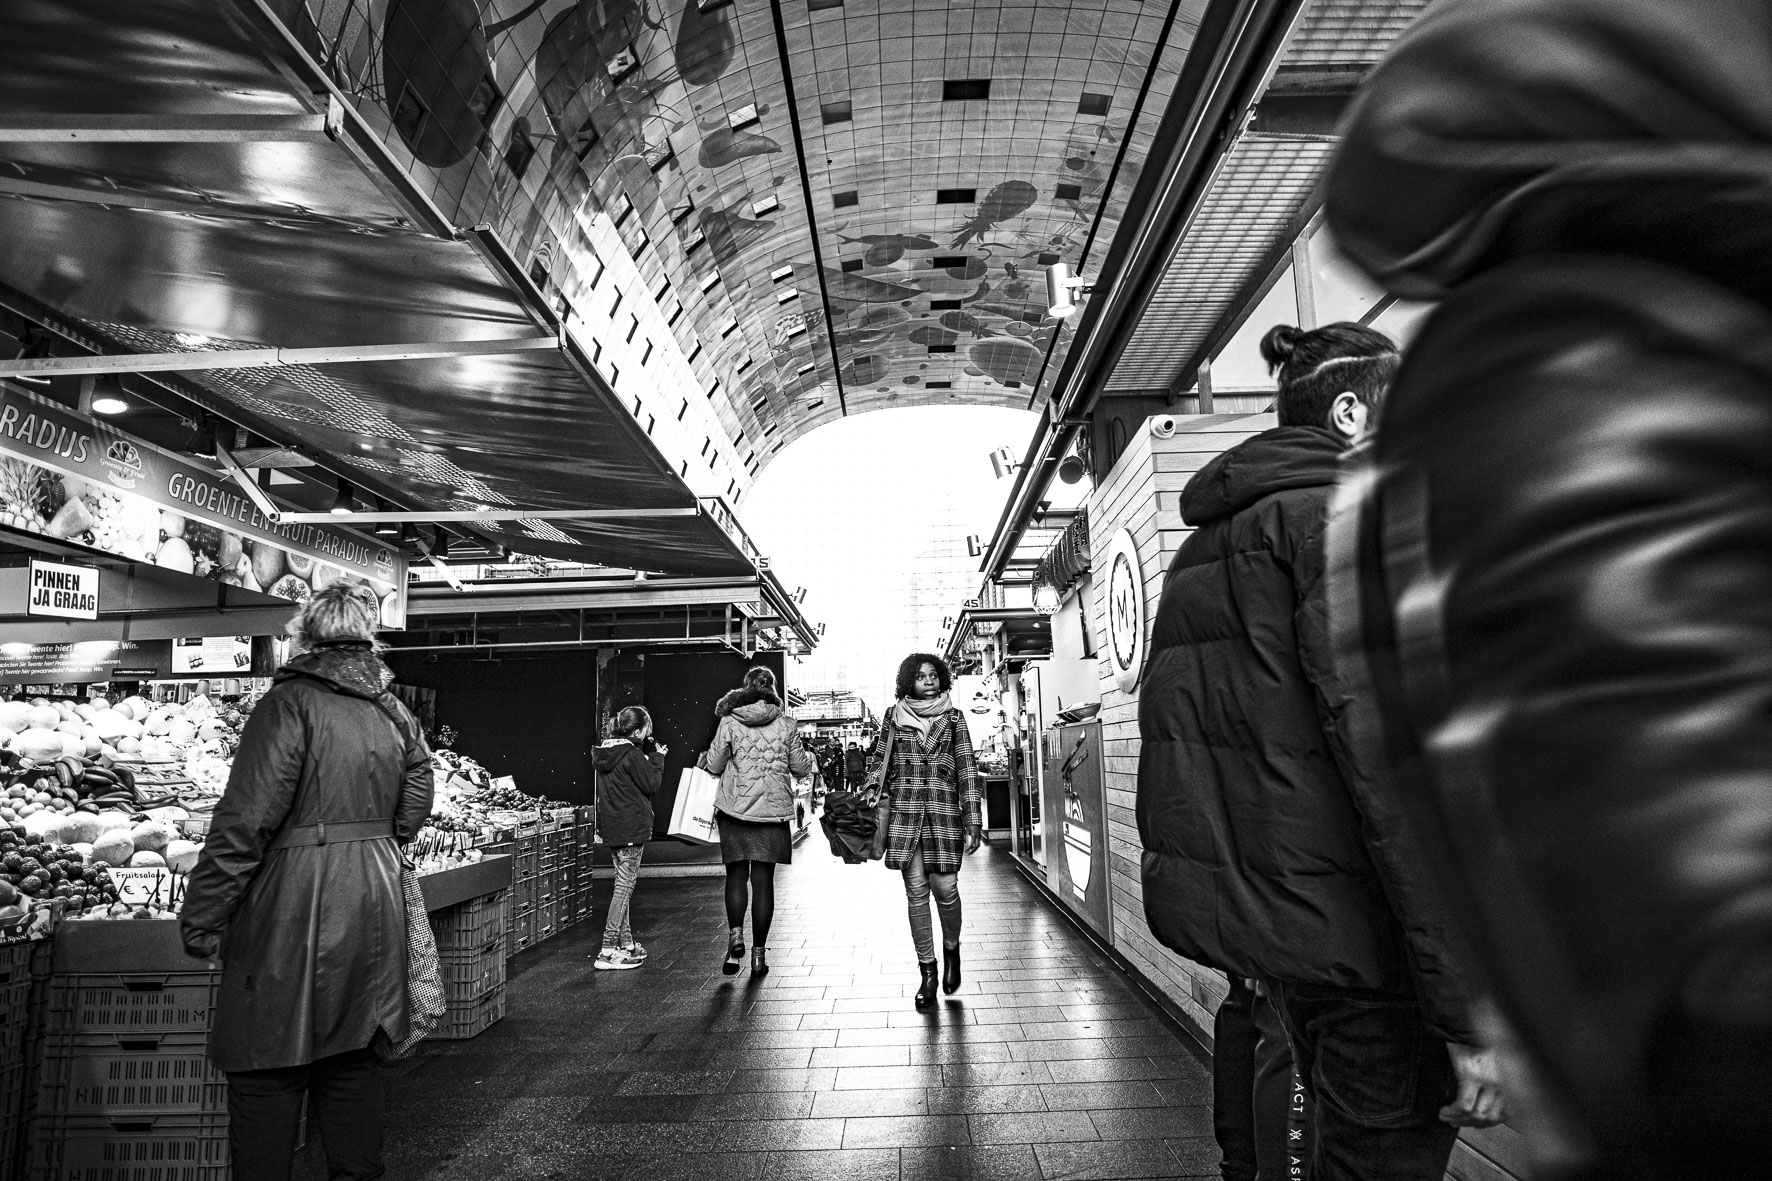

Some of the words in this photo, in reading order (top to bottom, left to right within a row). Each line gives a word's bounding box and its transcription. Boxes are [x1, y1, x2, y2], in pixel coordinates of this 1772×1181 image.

[168, 472, 250, 522] GROENTE
[315, 529, 370, 568] PARADIJS
[34, 568, 80, 592] PINNEN
[33, 588, 50, 607] JA
[53, 590, 95, 611] GRAAG
[963, 599, 979, 608] 45
[55, 643, 72, 653] hier!
[122, 641, 139, 650] Win.
